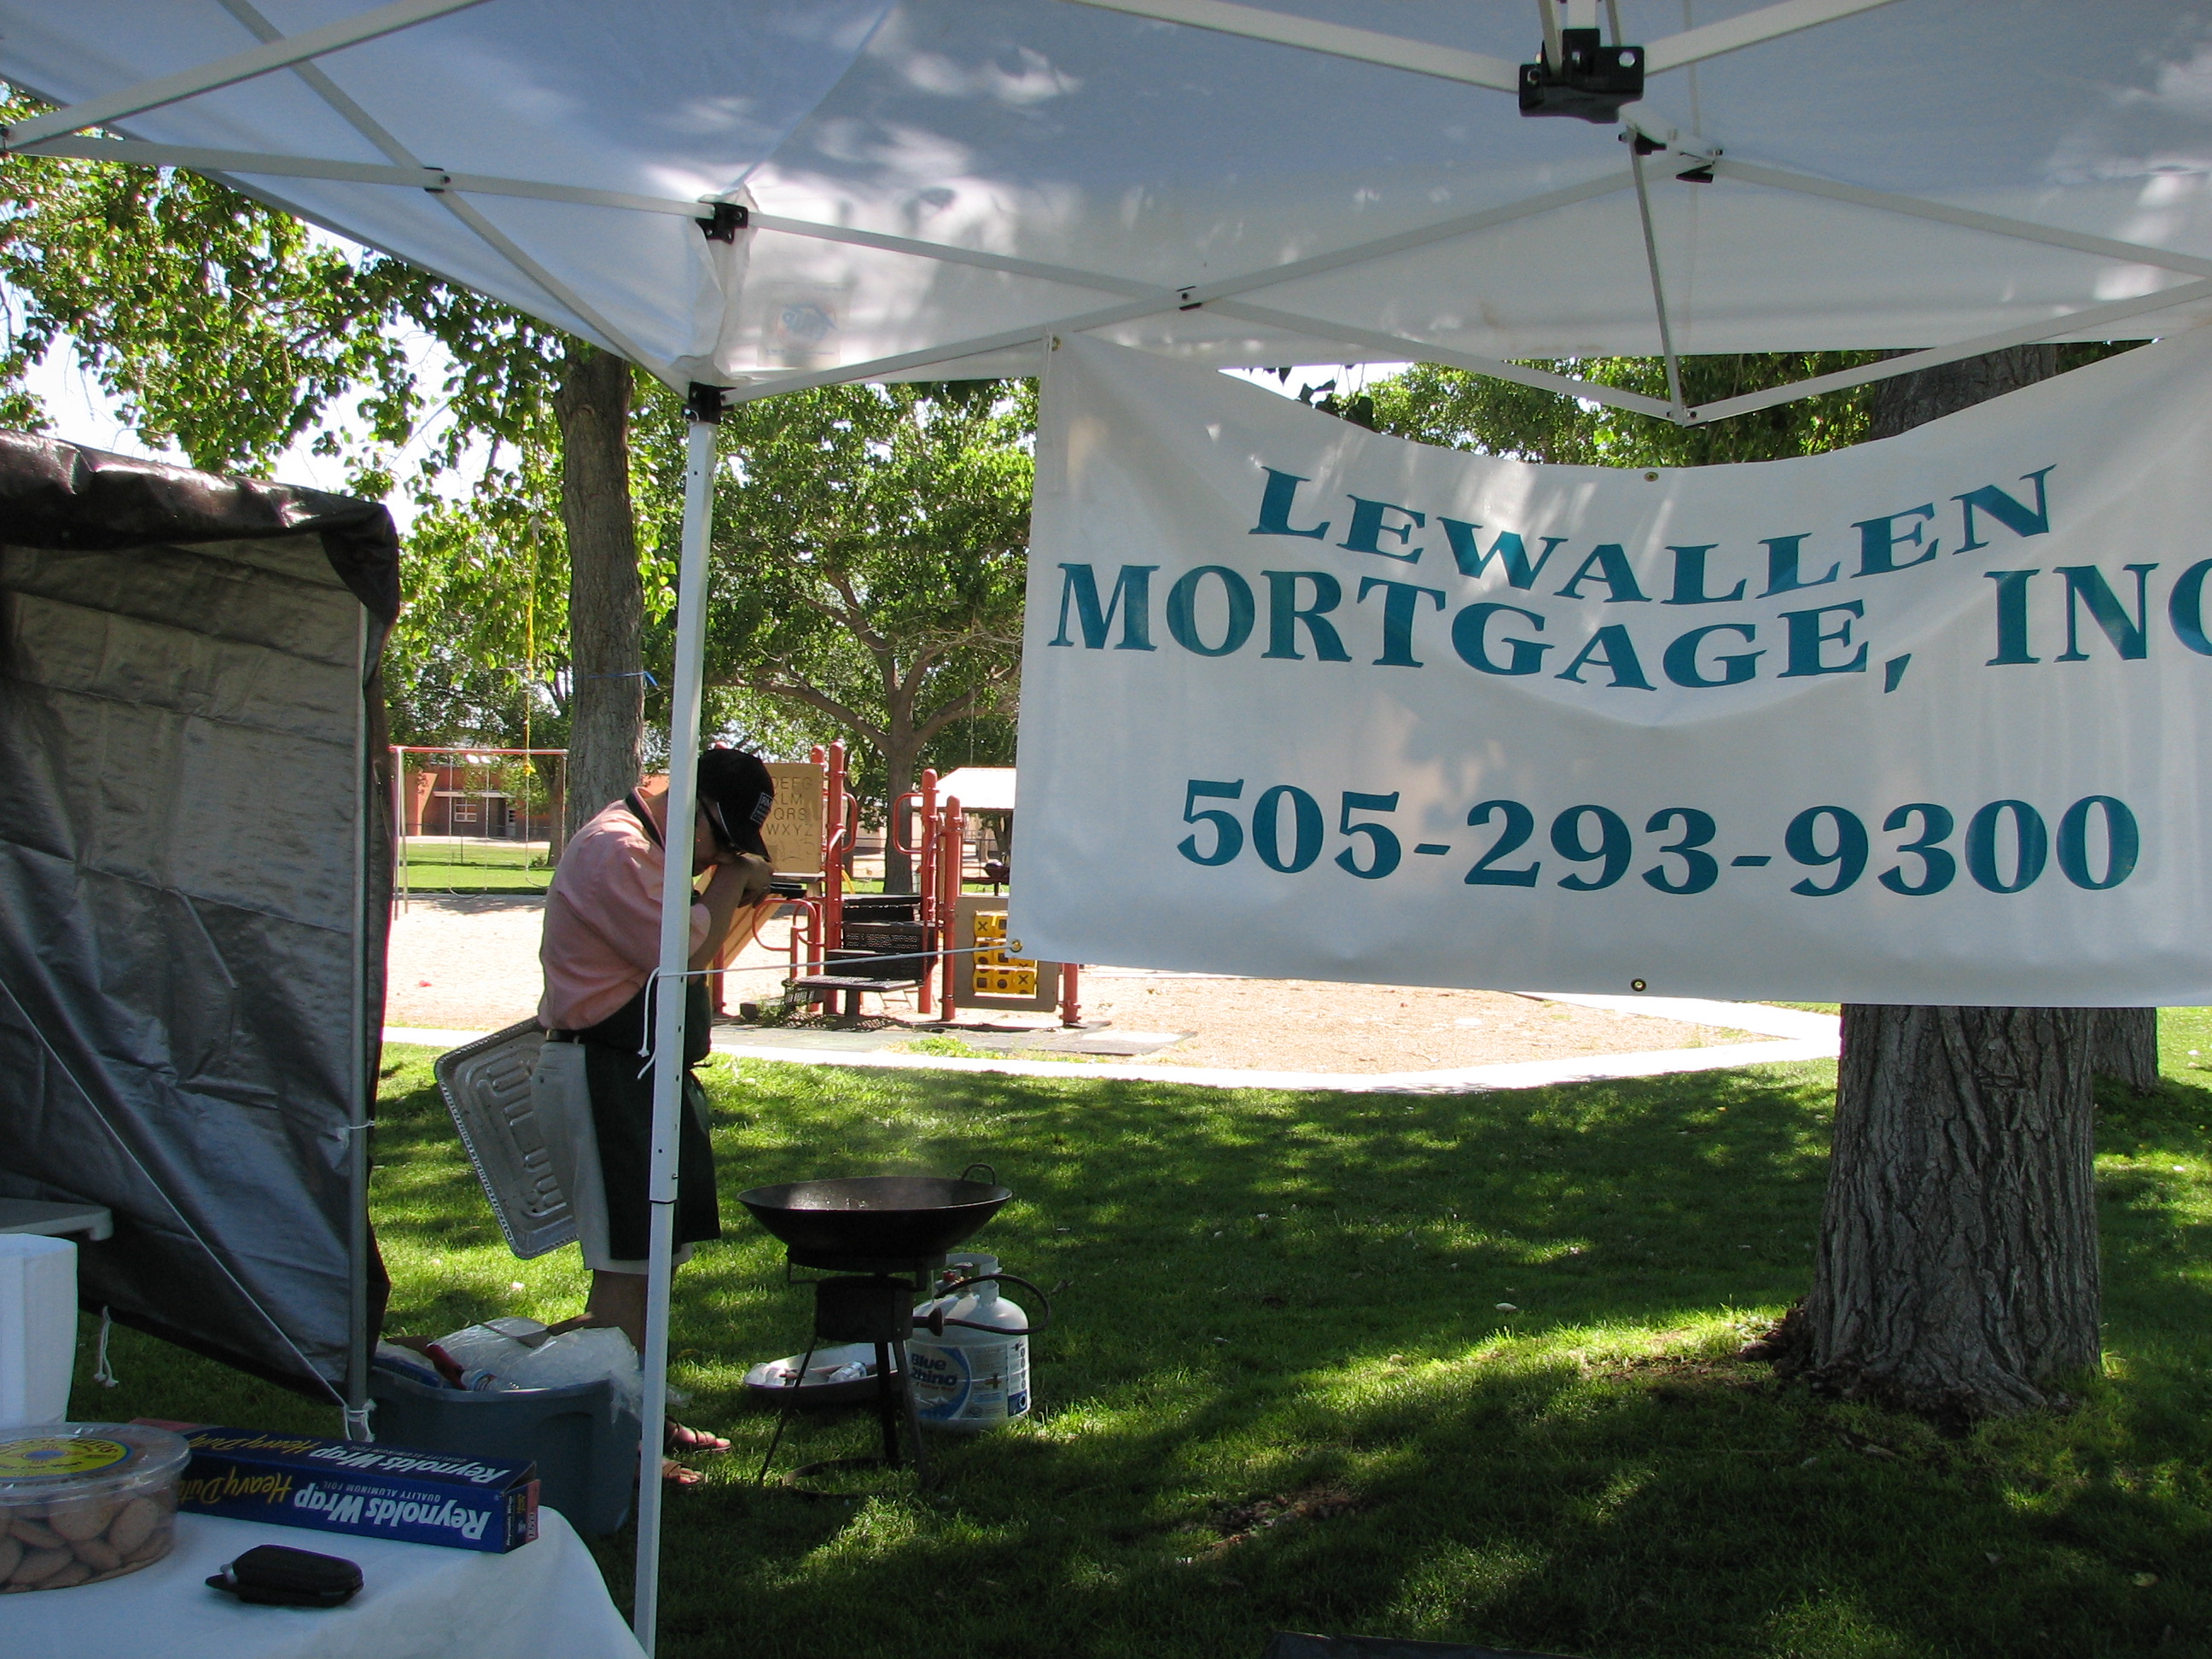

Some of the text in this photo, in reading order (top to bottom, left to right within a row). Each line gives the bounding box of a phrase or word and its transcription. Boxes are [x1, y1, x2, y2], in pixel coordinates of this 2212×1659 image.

[1249, 465, 2055, 605] LEWALLEN
[1048, 562, 1912, 692] MORTGAGE,
[774, 807, 806, 820] QRS
[766, 824, 813, 835] WXYZ
[1177, 778, 2140, 895] 505-293-9300
[911, 1352, 947, 1371] Blue
[240, 1435, 322, 1453] Heavy
[308, 1445, 376, 1470] Wrap
[377, 1457, 512, 1484] Reynolds
[223, 1466, 293, 1503] Heavy
[323, 1481, 442, 1503] QUALITY ALUMINUM FOIL
[294, 1482, 364, 1524] Wrap
[364, 1498, 492, 1540] Reynolds
